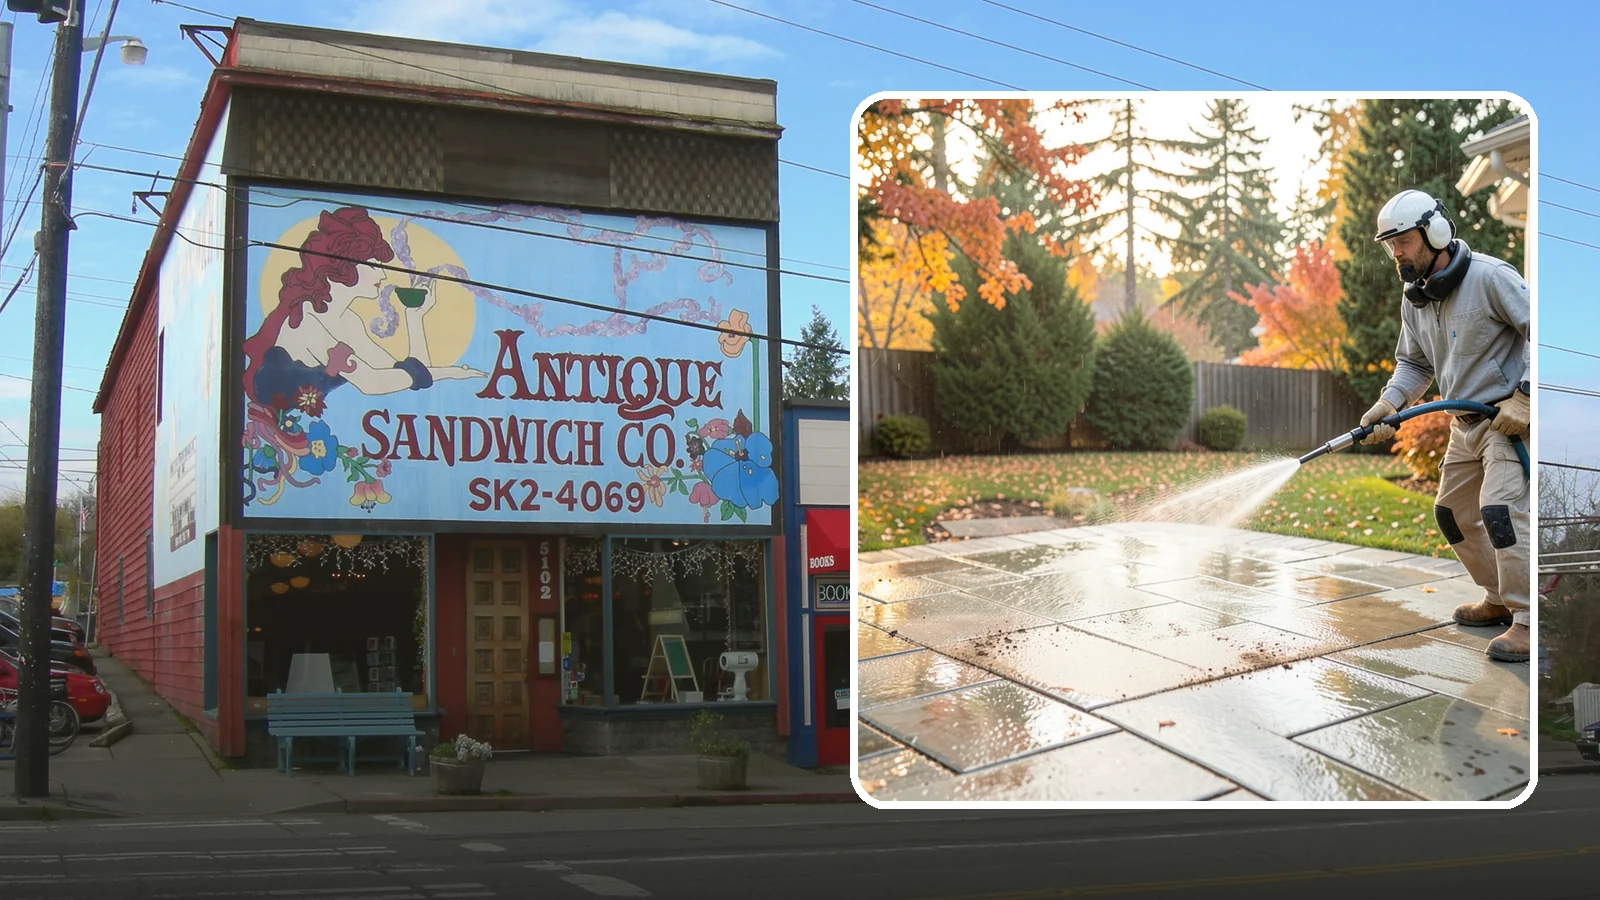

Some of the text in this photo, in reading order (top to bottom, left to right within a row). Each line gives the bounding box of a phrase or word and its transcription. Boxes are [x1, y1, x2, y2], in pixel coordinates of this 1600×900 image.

[476, 329, 723, 421] ANTIQUE
[361, 408, 685, 469] SANDWICH CO.
[468, 477, 646, 513] SK2-4069
[539, 541, 552, 600] 5102
[809, 555, 835, 569] BOOKS
